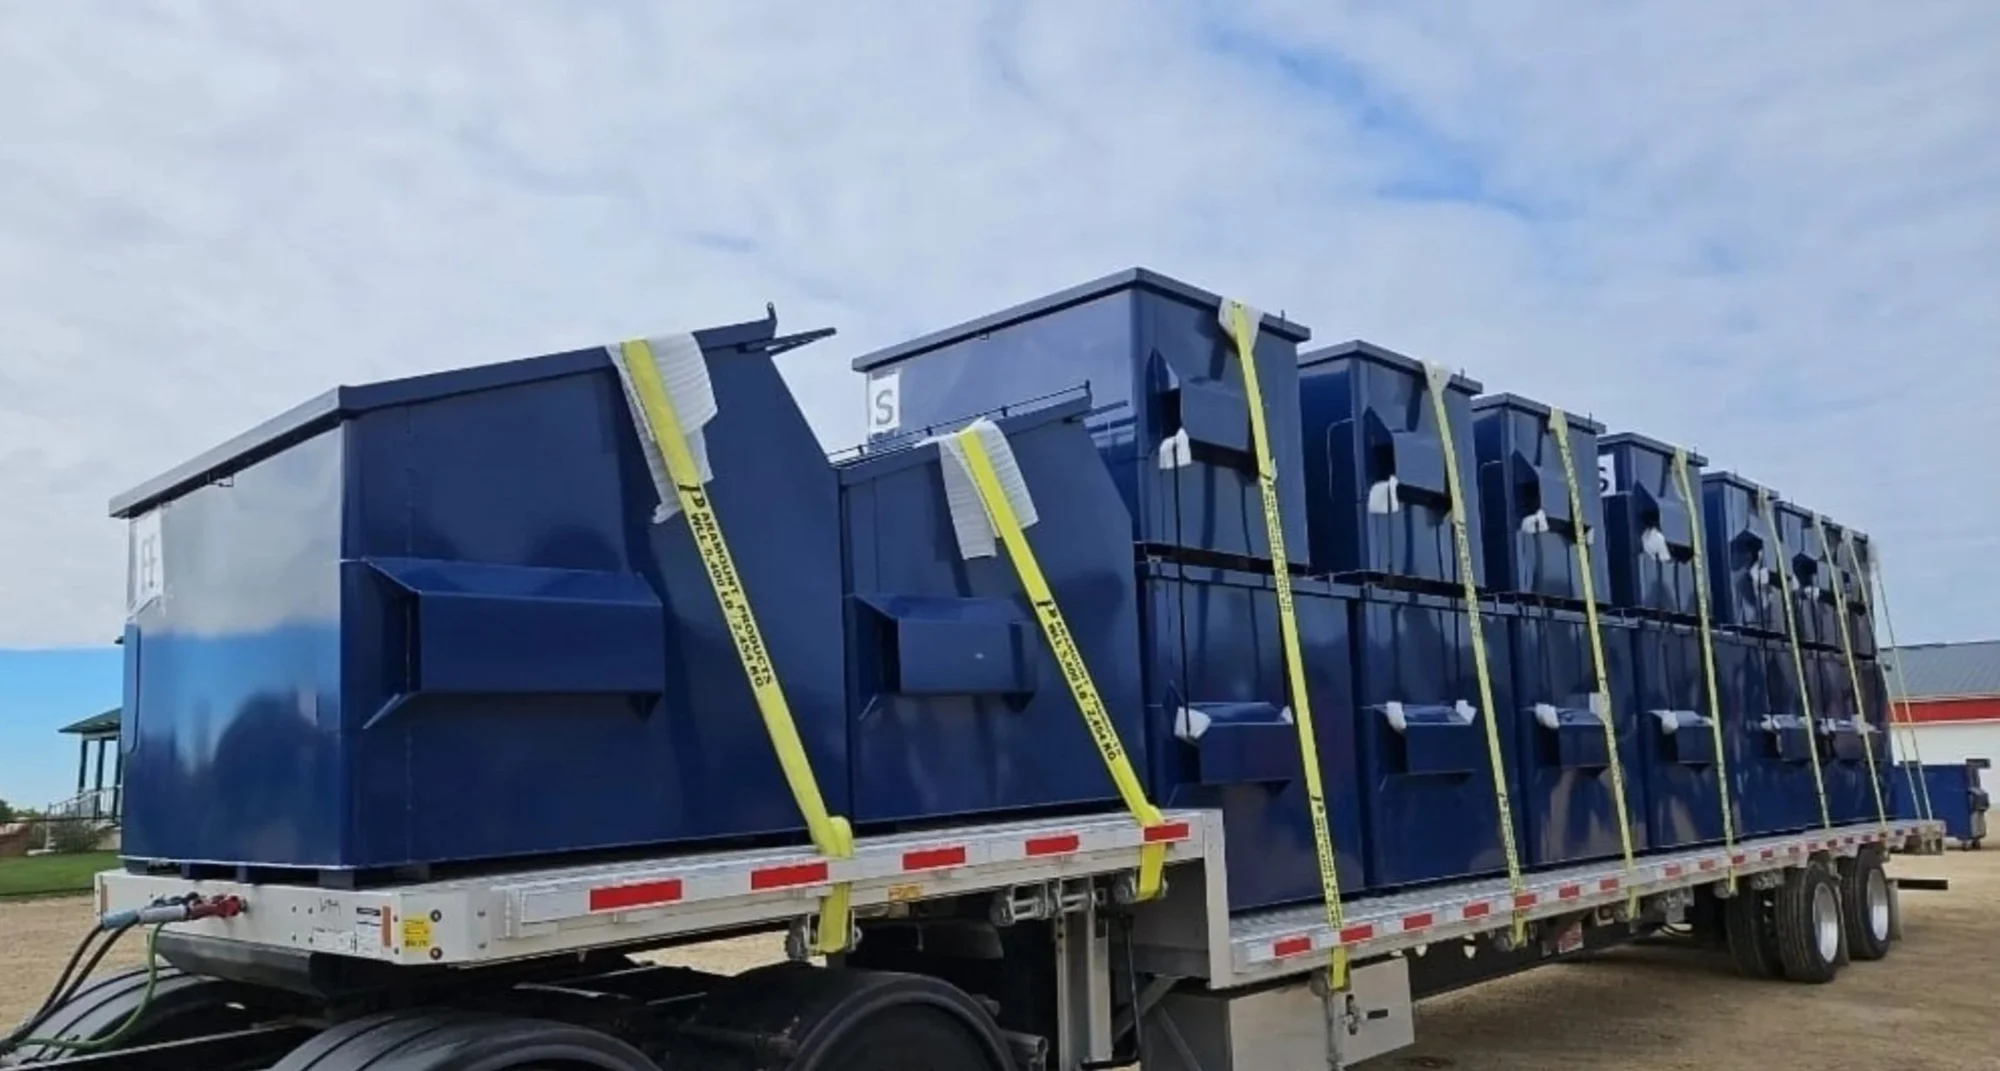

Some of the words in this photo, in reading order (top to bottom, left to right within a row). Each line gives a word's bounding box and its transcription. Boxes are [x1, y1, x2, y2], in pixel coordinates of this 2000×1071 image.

[876, 389, 893, 425] S
[691, 513, 708, 541] WLL
[749, 665, 764, 688] KG
[736, 604, 773, 686] PRODUCTS
